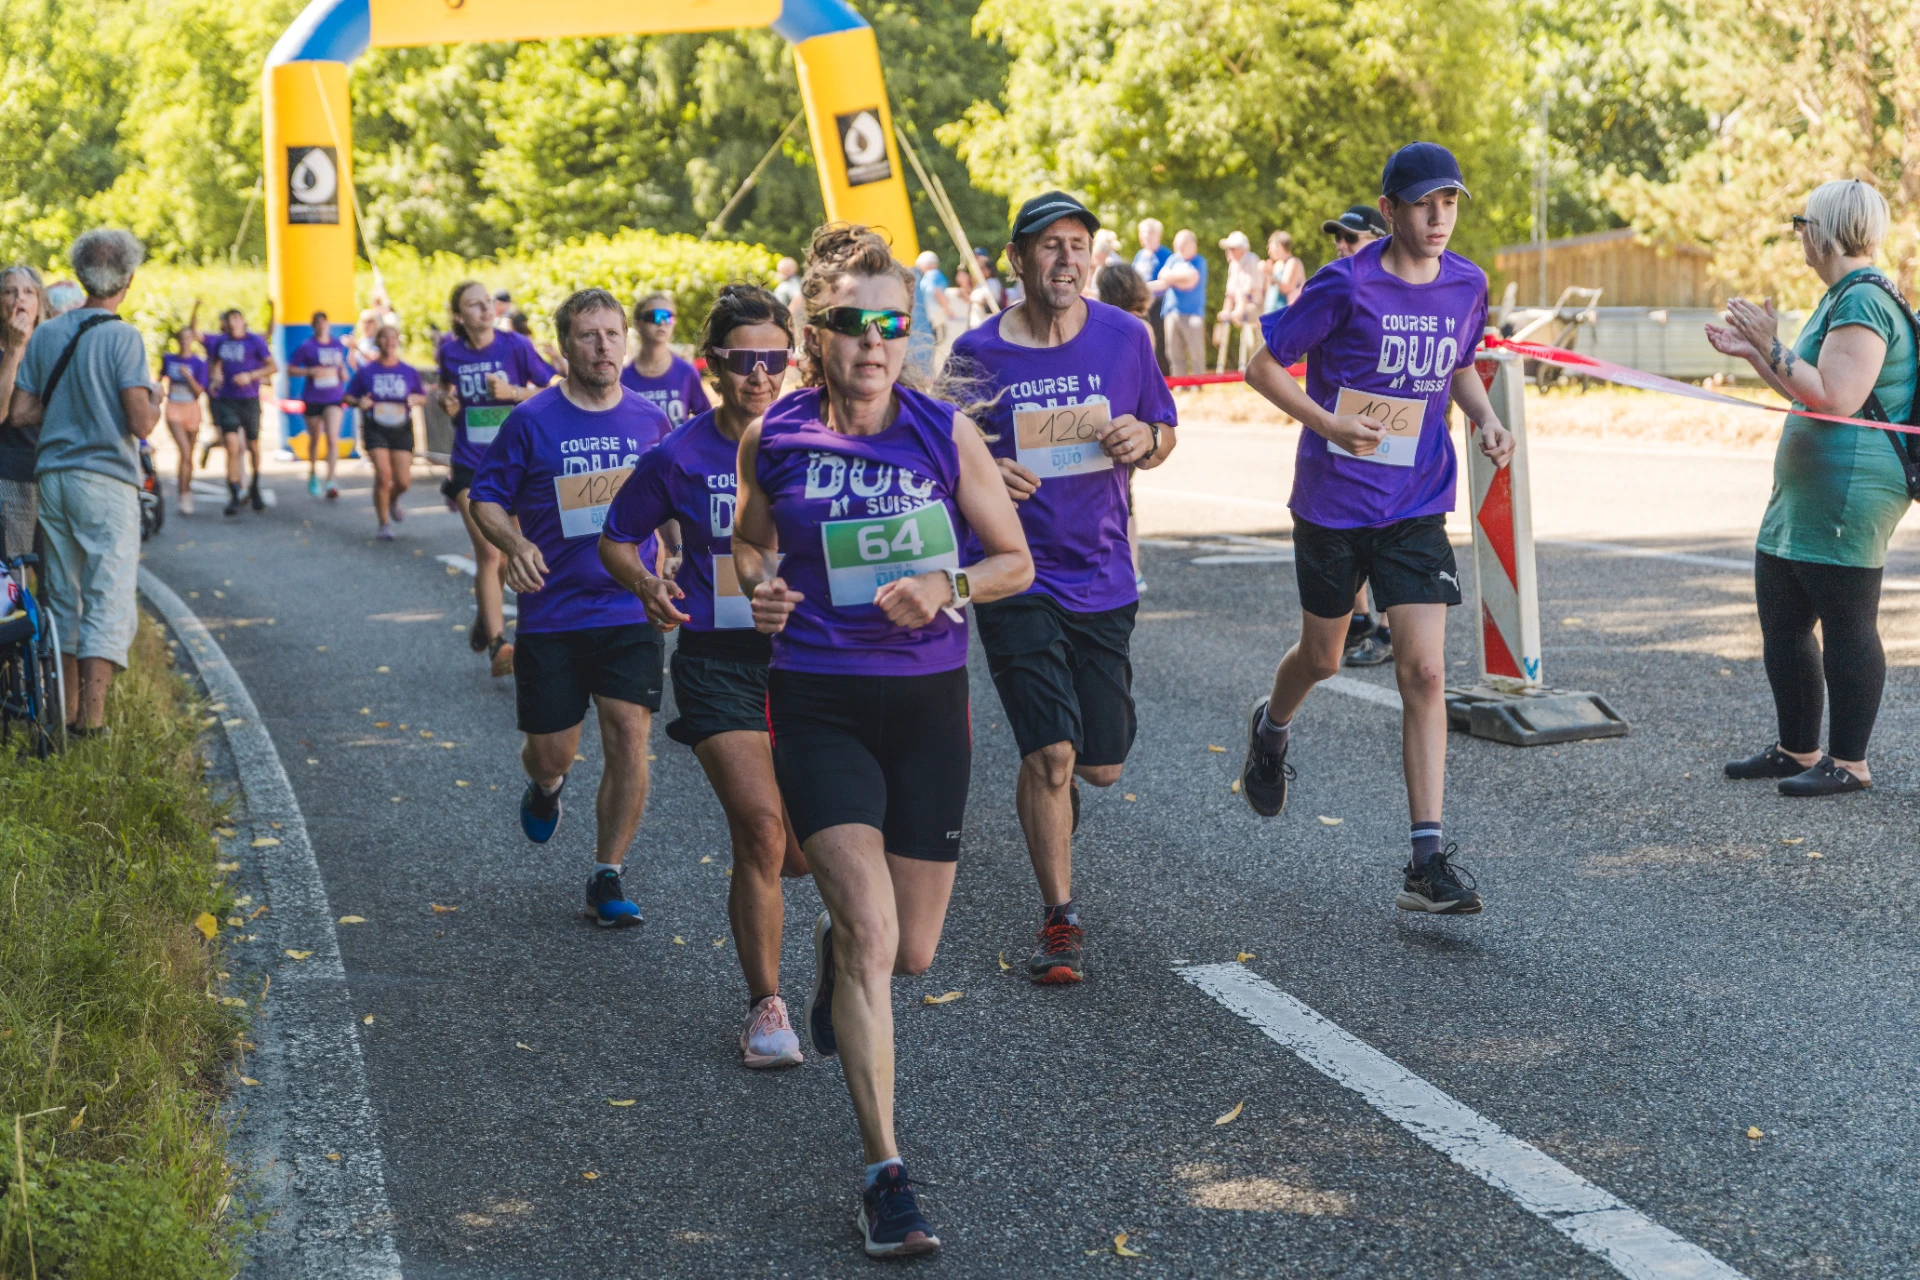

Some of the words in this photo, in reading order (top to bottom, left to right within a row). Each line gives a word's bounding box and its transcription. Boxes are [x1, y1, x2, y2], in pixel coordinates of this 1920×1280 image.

[1382, 314, 1438, 332] COURSE
[1376, 335, 1458, 378] DUO
[1010, 375, 1080, 399] COURSE
[1039, 410, 1095, 443] 126
[560, 436, 621, 454] COURSE
[1051, 452, 1082, 467] DUO
[857, 518, 924, 561] 64
